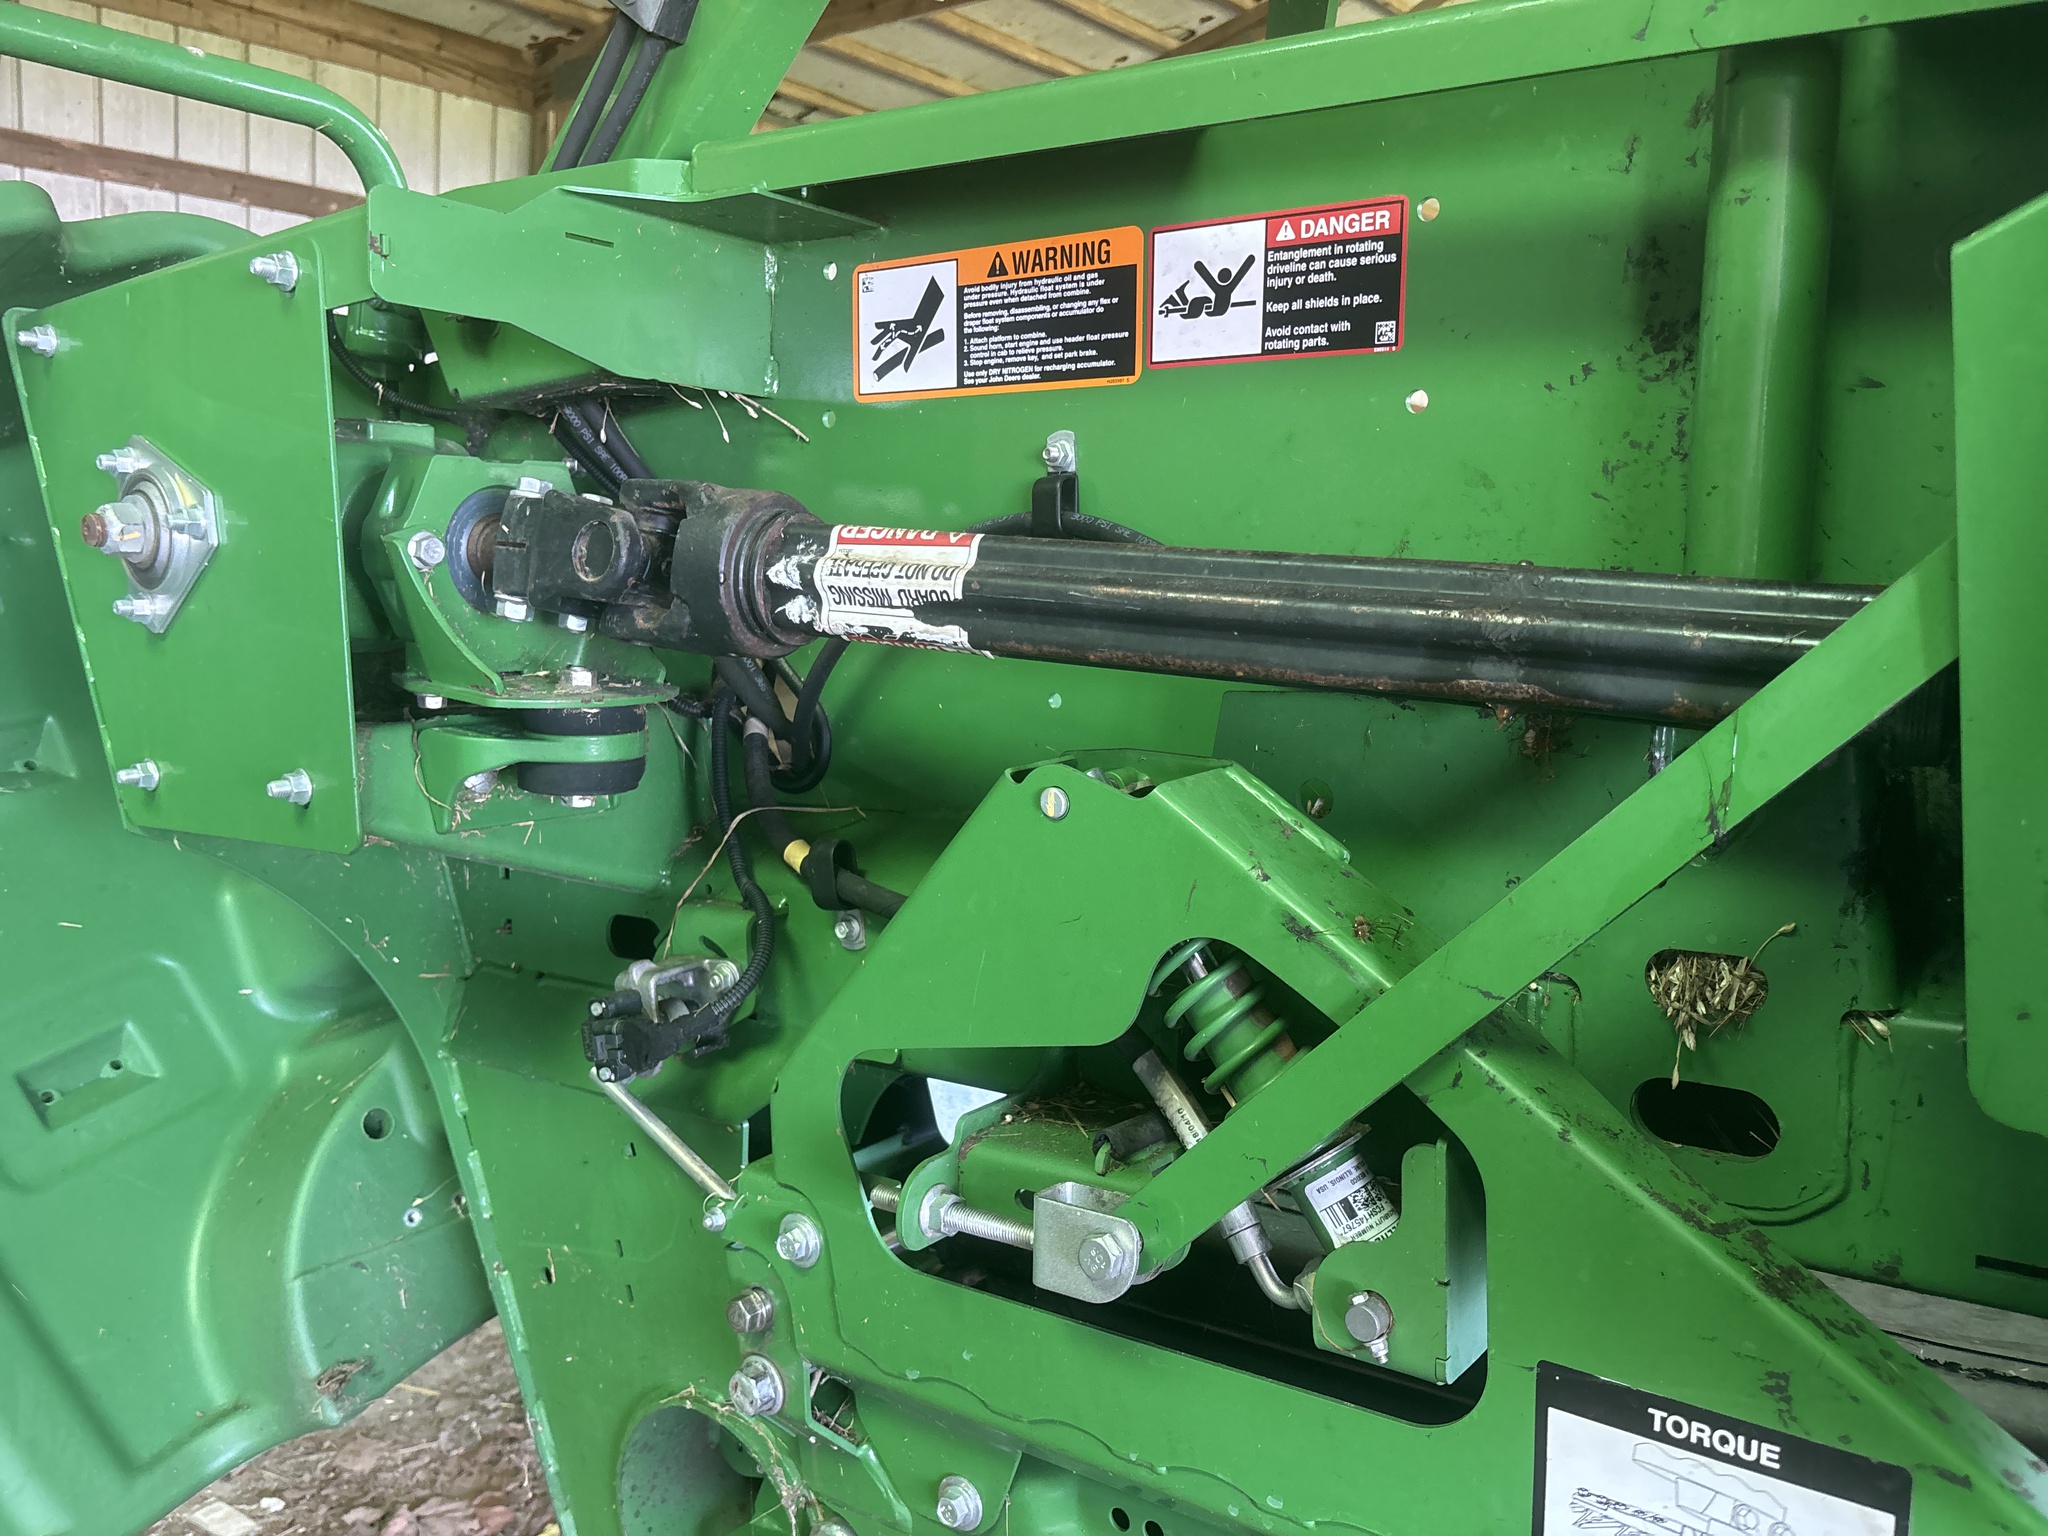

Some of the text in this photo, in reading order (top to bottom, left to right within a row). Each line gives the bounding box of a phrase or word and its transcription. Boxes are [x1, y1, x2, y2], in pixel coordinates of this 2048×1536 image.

[1301, 210, 1390, 239] DANGER
[1012, 239, 1110, 275] WARNING
[1267, 238, 1383, 264] Entanglement in rotating
[1266, 250, 1396, 274] driveline can cause serious
[963, 285, 979, 293] Avoid
[980, 283, 998, 292] bodily
[1000, 281, 1017, 290] injury
[1018, 279, 1032, 287] from
[1033, 275, 1062, 287] hydraulic
[1063, 274, 1071, 282] oil
[1086, 273, 1098, 281] gas
[963, 278, 1104, 300] under pressure. Hydraulic float system is under
[1266, 270, 1336, 290] injury or death.
[963, 301, 987, 309] pressure
[1020, 293, 1047, 301] detached
[1062, 288, 1091, 297] combine.
[1265, 291, 1382, 314] Keep all shields in place.
[963, 318, 980, 327] draper
[994, 315, 1014, 324] system
[1015, 311, 1050, 322] components
[1058, 307, 1094, 316] accumulator
[982, 308, 1008, 318] removing,
[1009, 304, 1051, 315] disassembling,
[1059, 300, 1086, 310] changing
[973, 324, 999, 334] following:
[988, 334, 1012, 343] platform
[1020, 331, 1046, 339] combine.
[1264, 319, 1350, 337] Avoid contact with
[969, 343, 987, 351] Sound
[988, 342, 1003, 350] horn,
[1018, 339, 1038, 348] engine
[1064, 335, 1085, 343] header
[1086, 333, 1099, 341] float
[1100, 332, 1128, 341] pressure
[1263, 335, 1329, 352] rotating parts.
[969, 350, 989, 358] control
[1036, 346, 1063, 354] pressure.
[969, 358, 982, 366] Stop
[983, 356, 1004, 365] engine,
[1027, 354, 1039, 362] key,
[1064, 350, 1077, 359] park
[975, 369, 987, 377] only
[1001, 365, 1033, 374] NITROGEN
[1043, 362, 1075, 372] recharging
[1076, 359, 1115, 368] accumulator.
[580, 428, 595, 444] PSI
[894, 564, 932, 580] NOT
[931, 565, 961, 582] DO
[827, 585, 892, 607] MISSING
[1328, 1169, 1353, 1186] ILLINOIS,
[1316, 1184, 1328, 1194] USA
[1350, 1222, 1375, 1240] NUMBER
[1647, 1407, 1781, 1469] TORQUE
